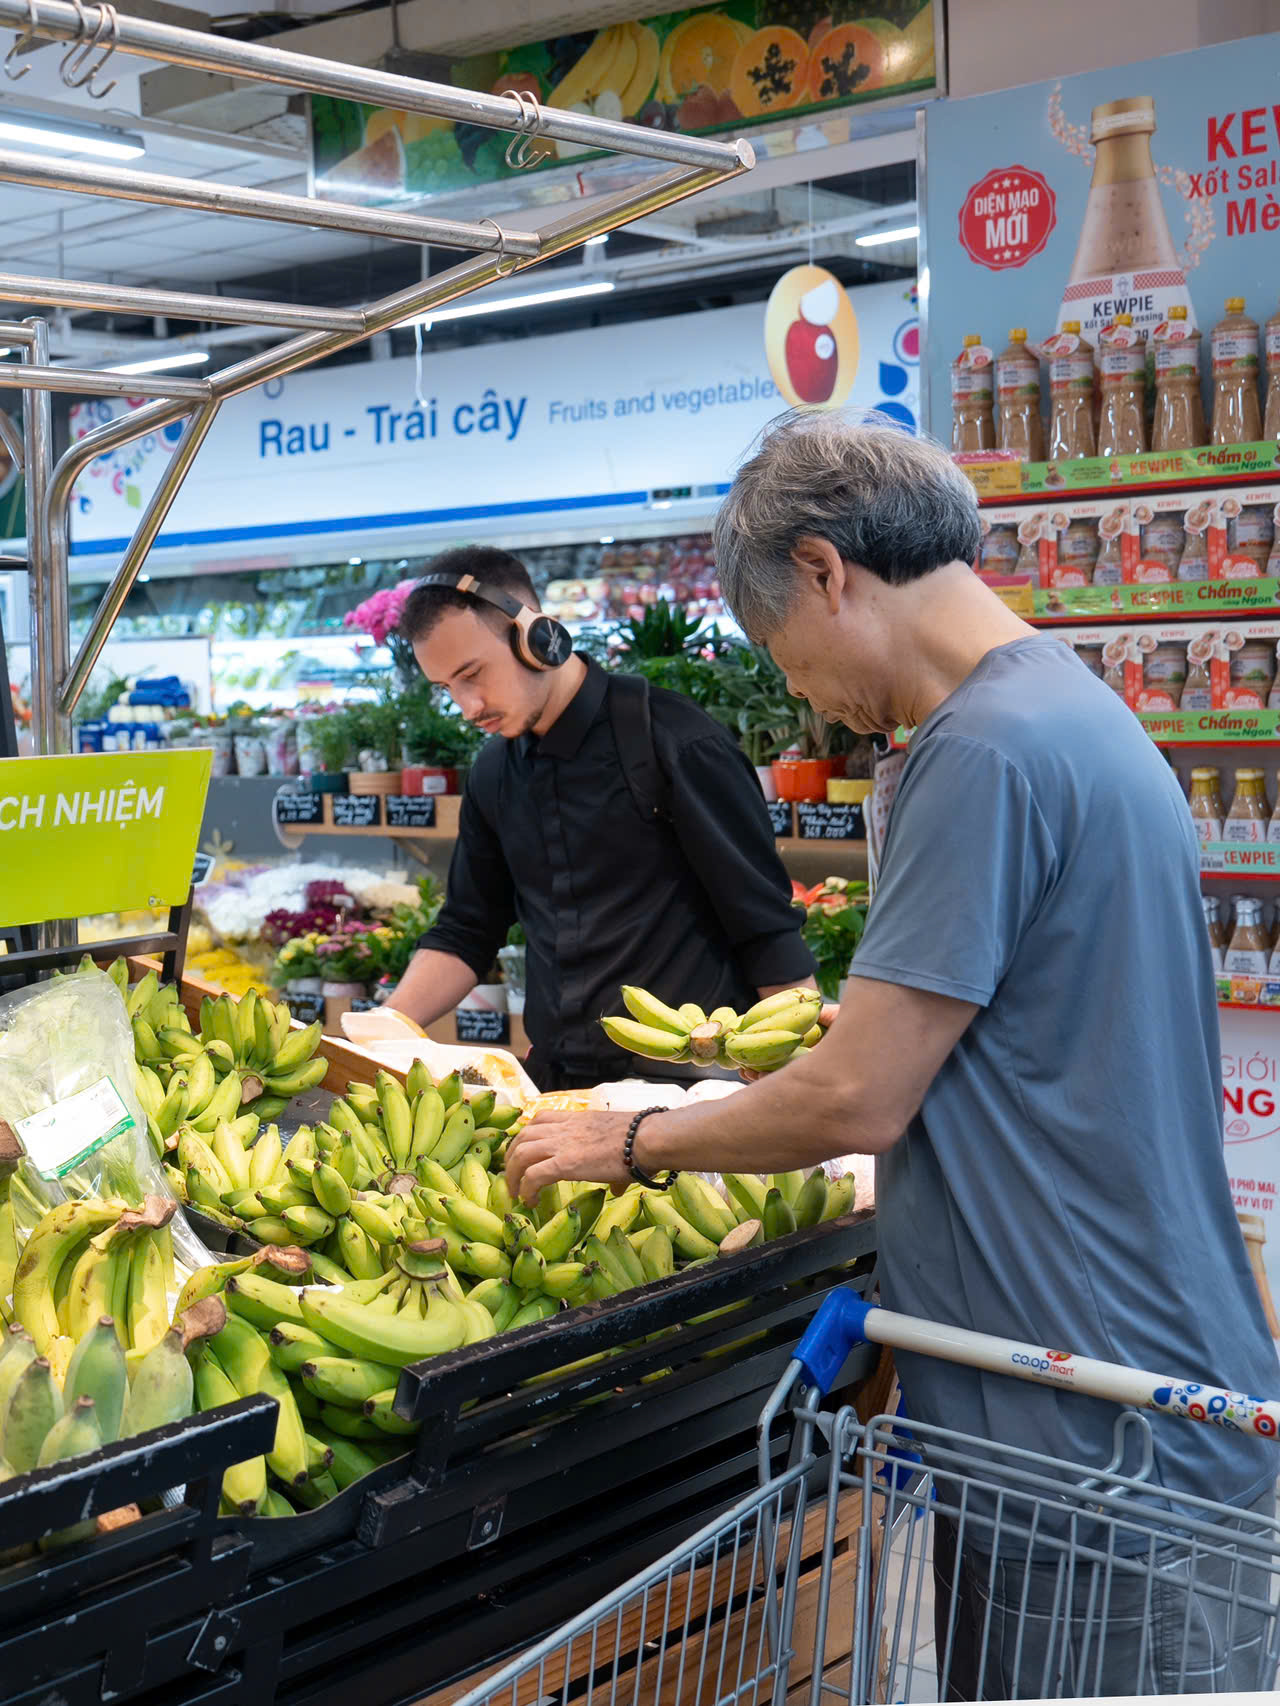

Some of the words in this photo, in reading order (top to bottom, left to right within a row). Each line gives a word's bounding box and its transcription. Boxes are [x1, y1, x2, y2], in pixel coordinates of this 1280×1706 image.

[1208, 104, 1280, 162] KE
[1188, 166, 1229, 199] Xốt
[1238, 160, 1280, 191] Sal
[975, 192, 1005, 217] DIỆN
[1009, 188, 1039, 212] MẠO
[1226, 193, 1280, 237] Mè
[985, 209, 1028, 250] MỚI
[1093, 295, 1153, 317] KEWPIE
[259, 419, 330, 457] Rau
[366, 398, 437, 444] Trái
[453, 389, 528, 441] cây
[548, 398, 607, 424] Fruits
[614, 391, 656, 417] and
[1130, 457, 1184, 476] KEWPIE
[1197, 448, 1241, 466] Chấm
[1130, 590, 1184, 606] KEWPIE
[1197, 582, 1242, 600] Chấm
[1141, 719, 1185, 734] EWPIE
[1198, 713, 1242, 730] Chấm
[54, 780, 165, 829] NHIỆM
